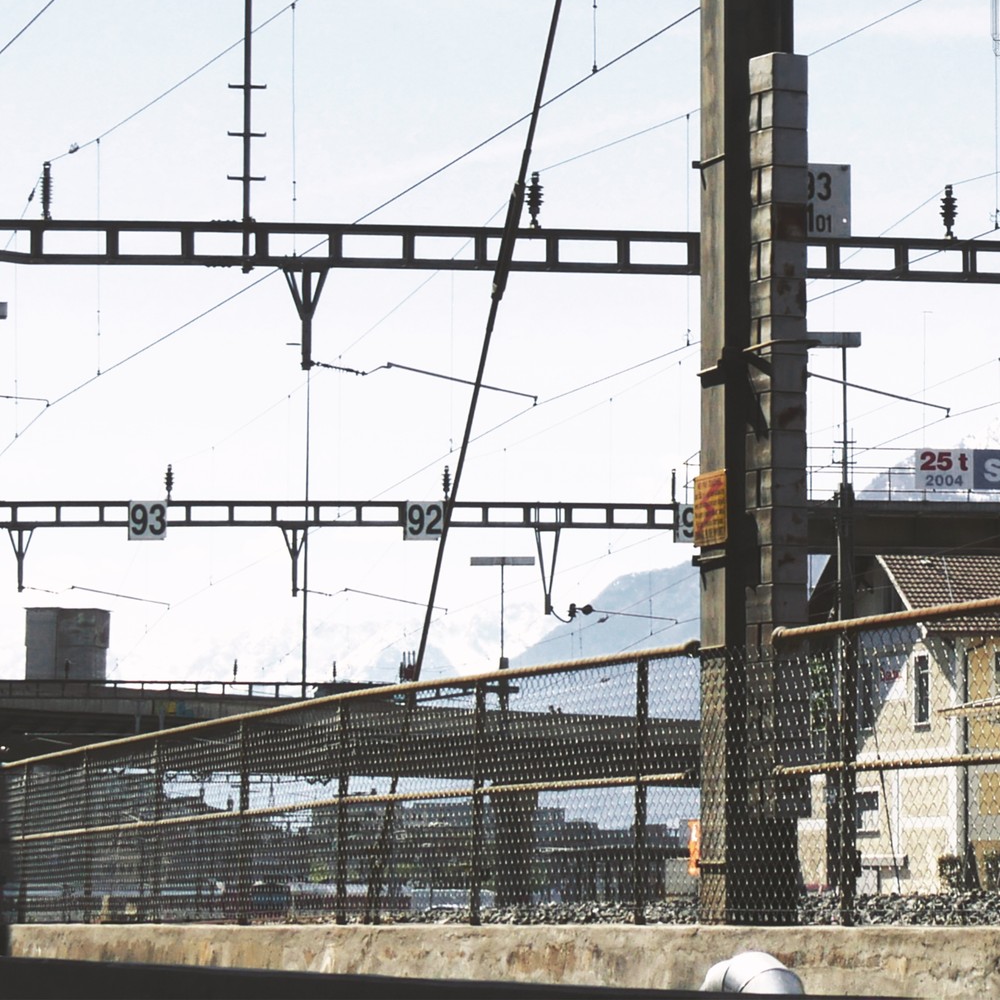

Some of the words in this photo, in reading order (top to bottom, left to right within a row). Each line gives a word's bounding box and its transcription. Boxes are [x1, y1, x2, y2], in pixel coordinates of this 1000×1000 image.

[920, 451, 953, 472] 25
[958, 453, 969, 472] t
[925, 474, 964, 487] 2004
[131, 503, 167, 536] 93
[408, 503, 443, 536] 92
